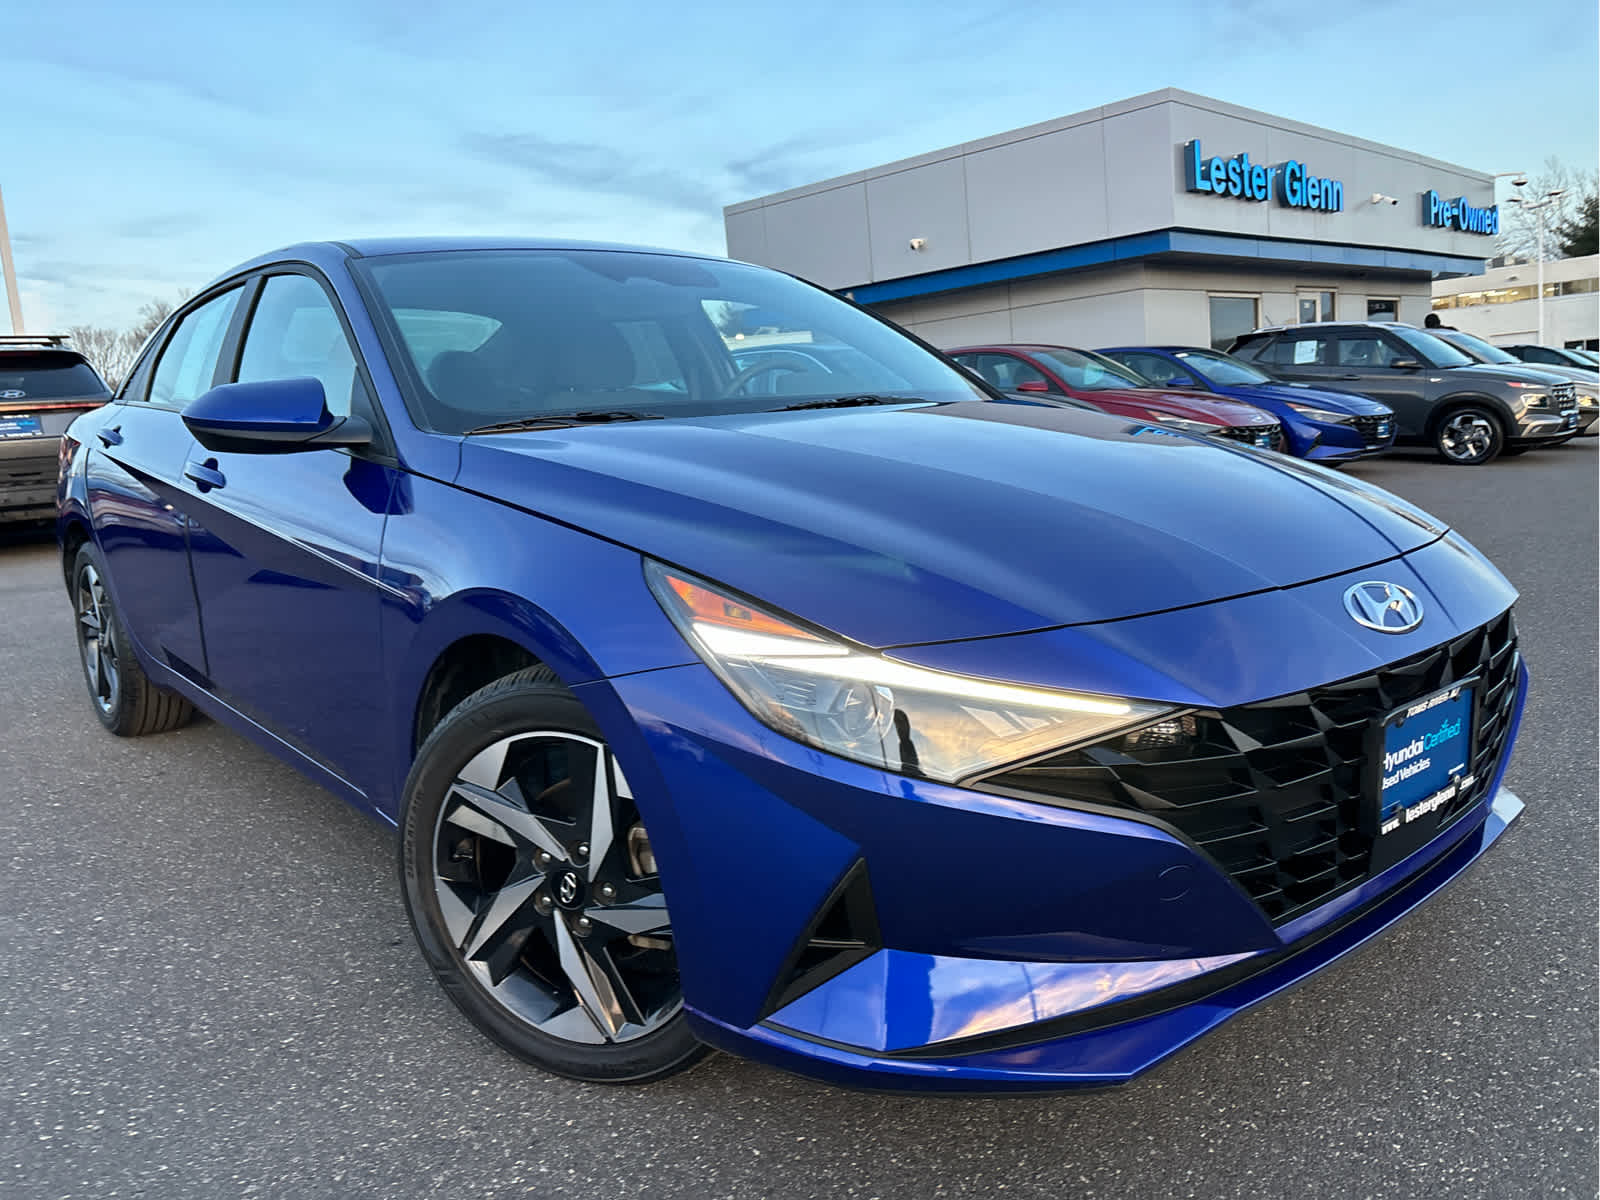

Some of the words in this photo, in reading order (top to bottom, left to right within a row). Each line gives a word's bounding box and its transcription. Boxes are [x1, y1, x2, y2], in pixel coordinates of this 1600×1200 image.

[1190, 139, 1276, 200] Lester
[1283, 159, 1344, 212] Glenn
[1429, 190, 1498, 234] Pre-Owned
